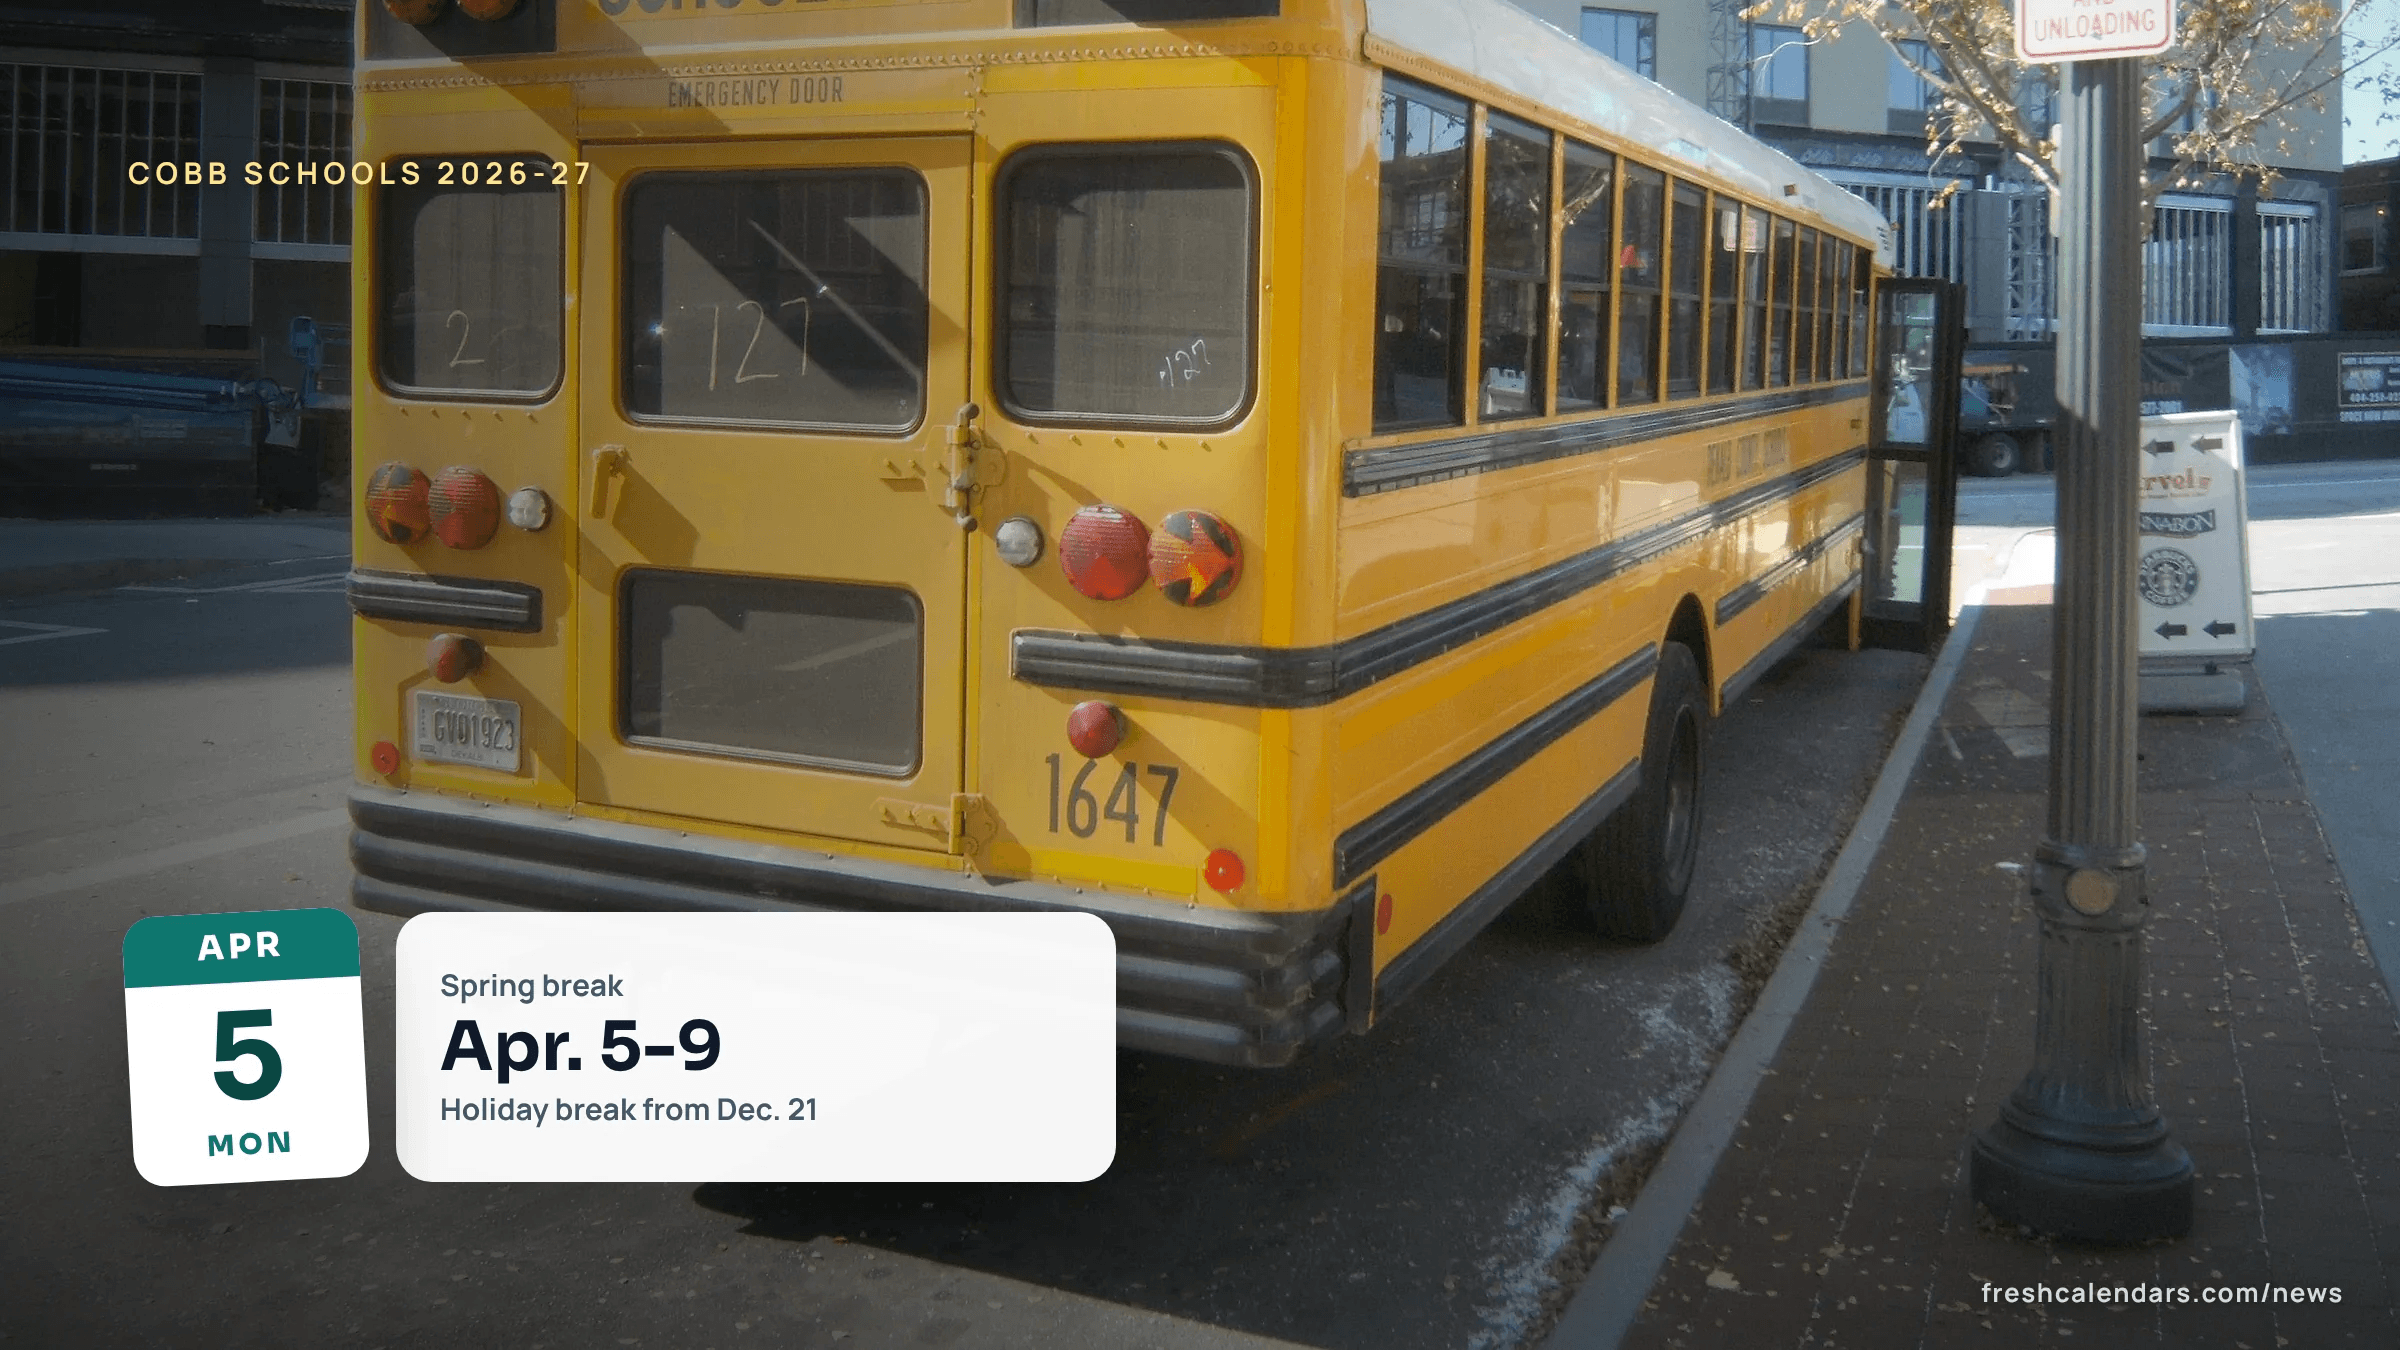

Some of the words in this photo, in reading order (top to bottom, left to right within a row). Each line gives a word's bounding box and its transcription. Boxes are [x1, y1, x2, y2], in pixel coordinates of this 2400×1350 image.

[2035, 8, 2156, 42] UNLOADING
[668, 78, 780, 109] EMERGENCY
[789, 75, 844, 105] DOOR
[446, 309, 485, 369] 2
[709, 297, 813, 391] 127
[1045, 752, 1180, 847] 1647
